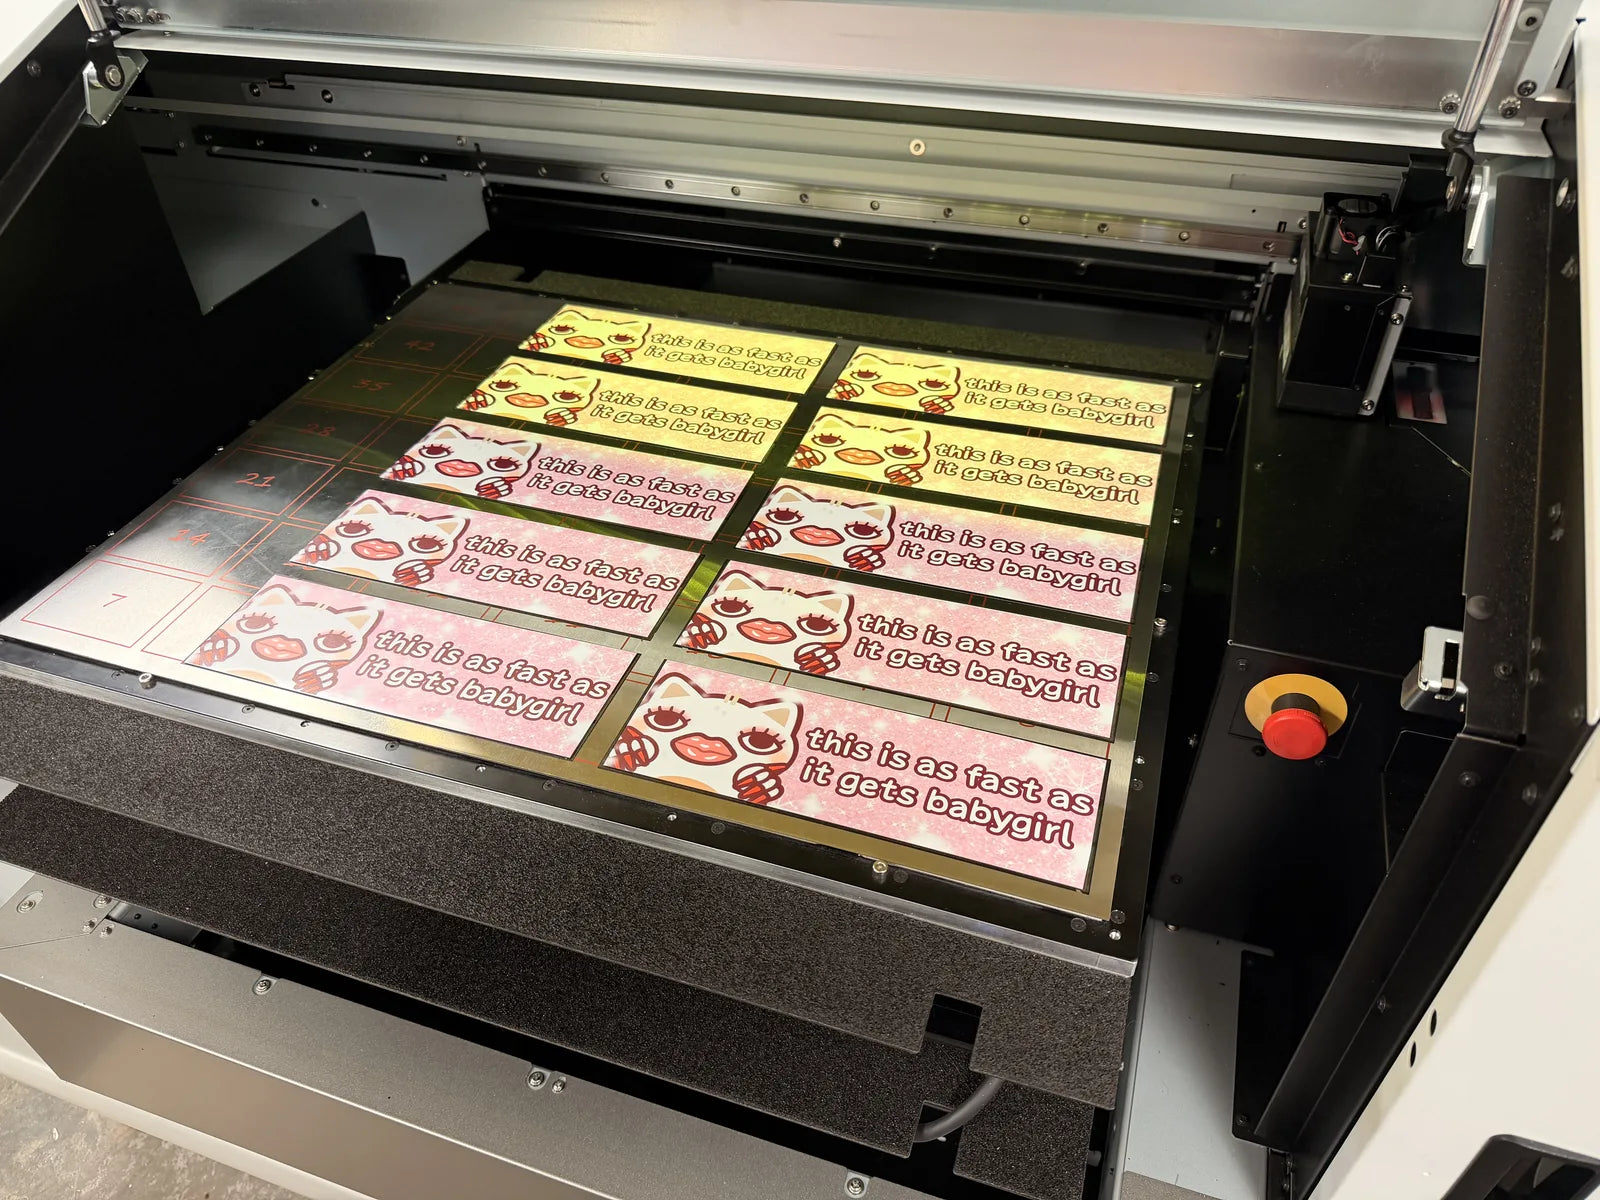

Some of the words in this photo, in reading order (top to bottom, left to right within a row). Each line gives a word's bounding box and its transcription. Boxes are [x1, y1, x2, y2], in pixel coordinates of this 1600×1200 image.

[405, 339, 436, 351] 42
[643, 345, 666, 358] it
[664, 351, 717, 365] gets
[717, 356, 807, 380] babygirl
[650, 333, 693, 348] this
[693, 338, 716, 351] is
[716, 344, 744, 355] as
[746, 347, 794, 363] fast
[794, 356, 823, 367] as
[351, 378, 393, 392] 35
[964, 377, 1013, 393] this
[1016, 383, 1039, 397] is
[1042, 389, 1073, 401] as
[1076, 392, 1132, 409] fast
[1135, 402, 1167, 414] as
[300, 422, 336, 437] 28
[589, 404, 615, 419] it
[612, 411, 669, 428] gets
[669, 417, 766, 445] babygirl
[598, 390, 644, 407] this
[644, 396, 669, 411] is
[668, 403, 699, 416] as
[701, 407, 752, 425] fast
[752, 417, 783, 430] as
[964, 391, 988, 405] it
[989, 397, 1047, 413] gets
[1051, 403, 1155, 429] babygirl
[234, 472, 276, 488] 21
[537, 456, 587, 476] this
[586, 464, 613, 481] is
[612, 472, 646, 487] as
[647, 476, 703, 498] fast
[702, 489, 736, 504] as
[933, 459, 959, 476] it
[960, 467, 1023, 486] gets
[1027, 473, 1140, 505] babygirl
[934, 443, 986, 462] this
[990, 450, 1015, 466] is
[1017, 457, 1051, 472] as
[1055, 461, 1115, 482] fast
[1118, 472, 1153, 487] as
[526, 473, 554, 490] it
[550, 481, 612, 501] gets
[612, 489, 717, 522] babygirl
[167, 529, 211, 547] 14
[899, 521, 955, 543] this
[959, 529, 986, 549] is
[989, 538, 1026, 555] as
[1030, 543, 1095, 568] fast
[1098, 557, 1137, 575] as
[449, 554, 481, 575] it
[475, 564, 544, 588] gets
[542, 574, 658, 613] babygirl
[464, 535, 519, 558] this
[517, 544, 547, 564] is
[545, 554, 582, 571] as
[583, 559, 644, 584] fast
[643, 574, 680, 592] as
[897, 540, 925, 560] it
[926, 549, 995, 572] gets
[998, 558, 1122, 596] babygirl
[102, 592, 128, 608] 7
[373, 630, 434, 658] this
[431, 641, 465, 665] is
[462, 653, 503, 674] as
[503, 659, 571, 691] fast
[569, 677, 611, 700] as
[857, 613, 919, 641] this
[922, 624, 952, 648] is
[955, 636, 995, 657] as
[1000, 641, 1072, 673] fast
[1075, 660, 1117, 682] as
[355, 654, 390, 679] it
[383, 666, 459, 695] gets
[456, 678, 585, 727] babygirl
[853, 636, 885, 661] it
[885, 648, 961, 677] gets
[964, 659, 1100, 708] babygirl
[805, 727, 873, 762] this
[877, 741, 911, 771] is
[913, 756, 958, 782] as
[964, 764, 1043, 804] fast
[1047, 788, 1094, 816] as
[799, 756, 835, 787] it
[835, 771, 919, 808] gets
[923, 786, 1074, 850] babygirl
